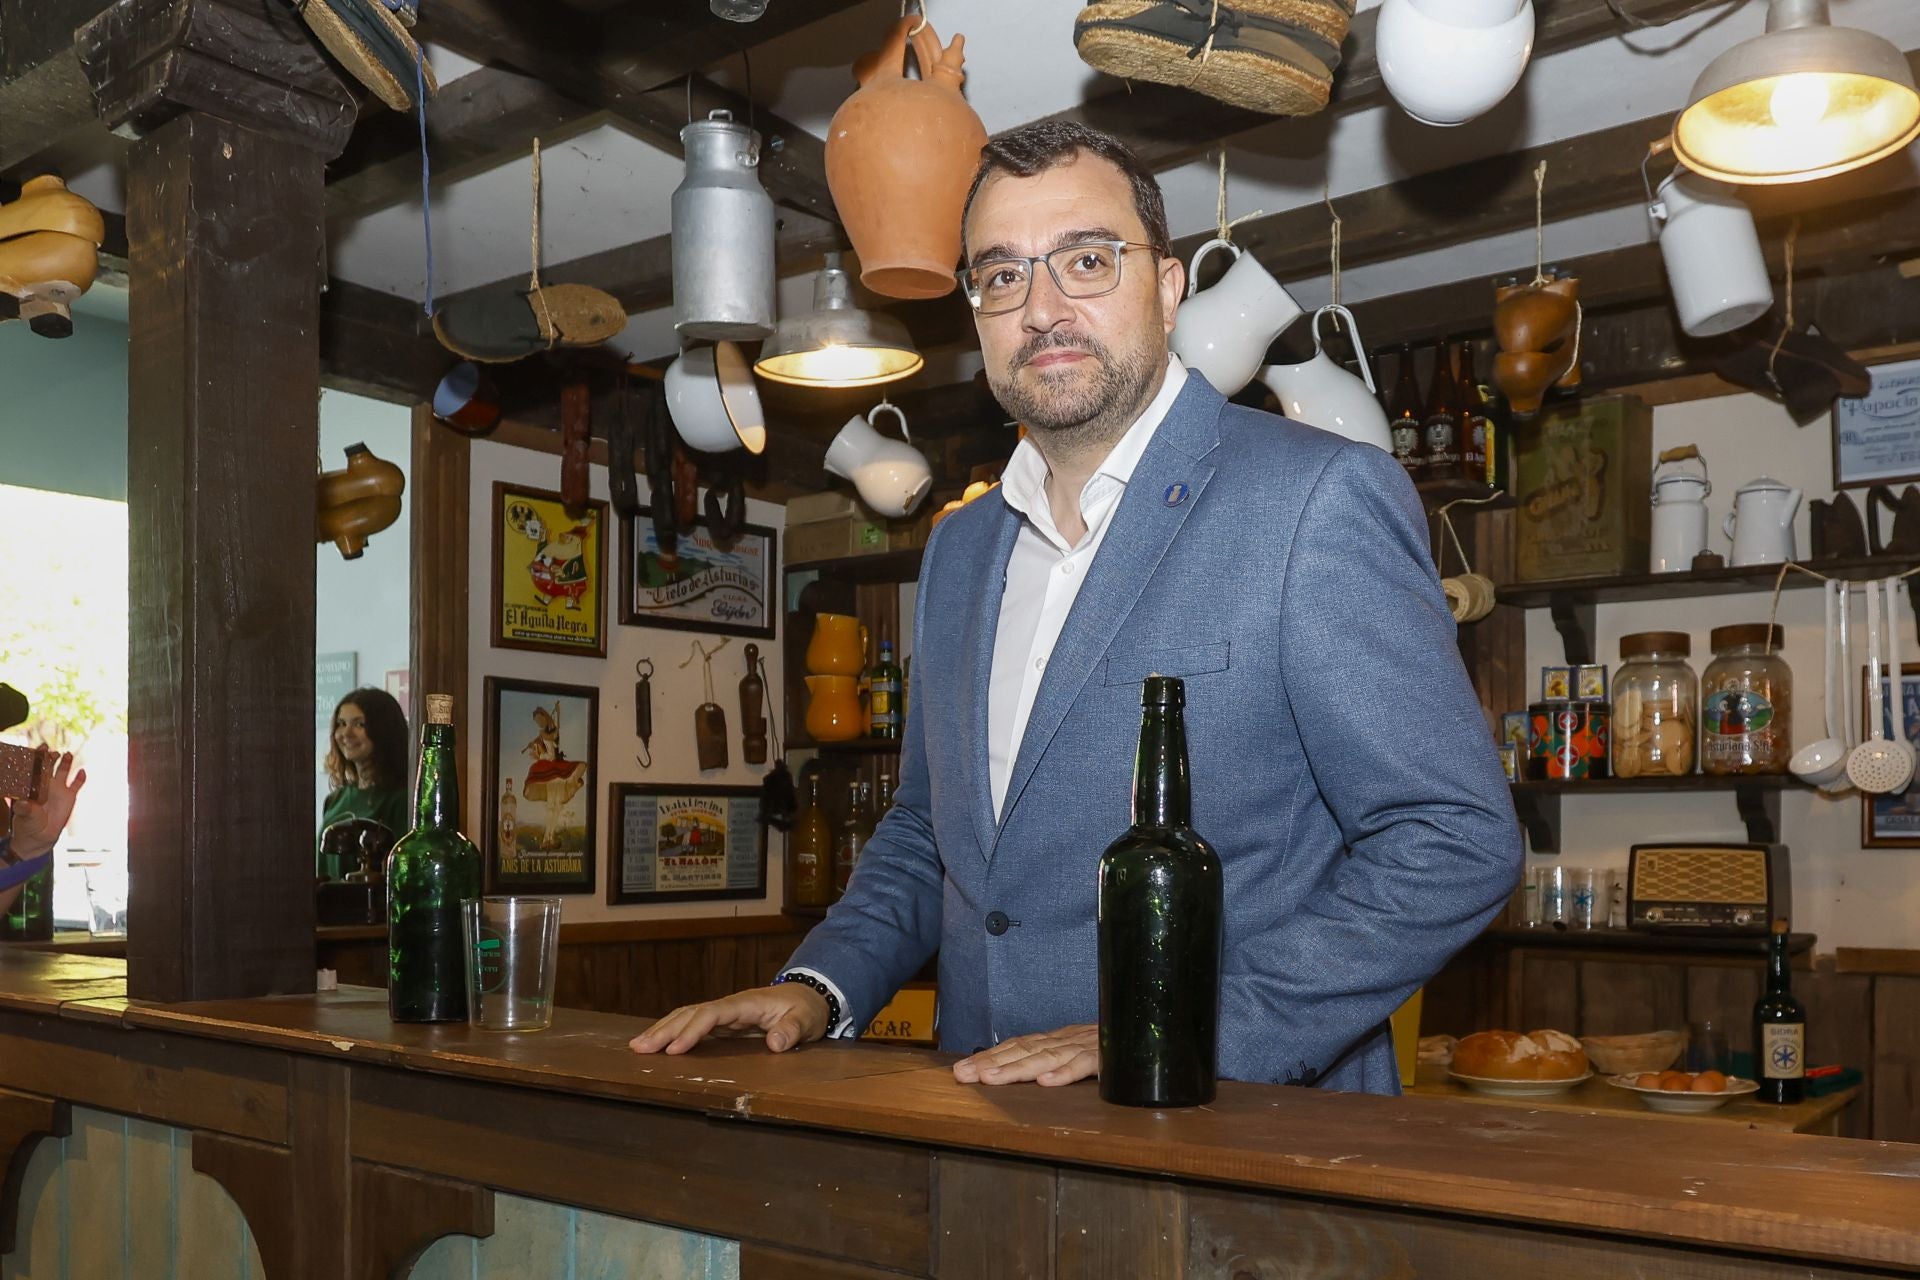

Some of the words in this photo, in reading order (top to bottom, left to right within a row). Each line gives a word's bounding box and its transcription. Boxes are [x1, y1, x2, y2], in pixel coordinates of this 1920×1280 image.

[505, 608, 517, 625] El
[557, 614, 588, 633] Negra
[520, 859, 529, 873] DE
[532, 859, 541, 873] LA
[544, 859, 582, 873] ASTURIANA
[866, 1020, 912, 1037] CAR
